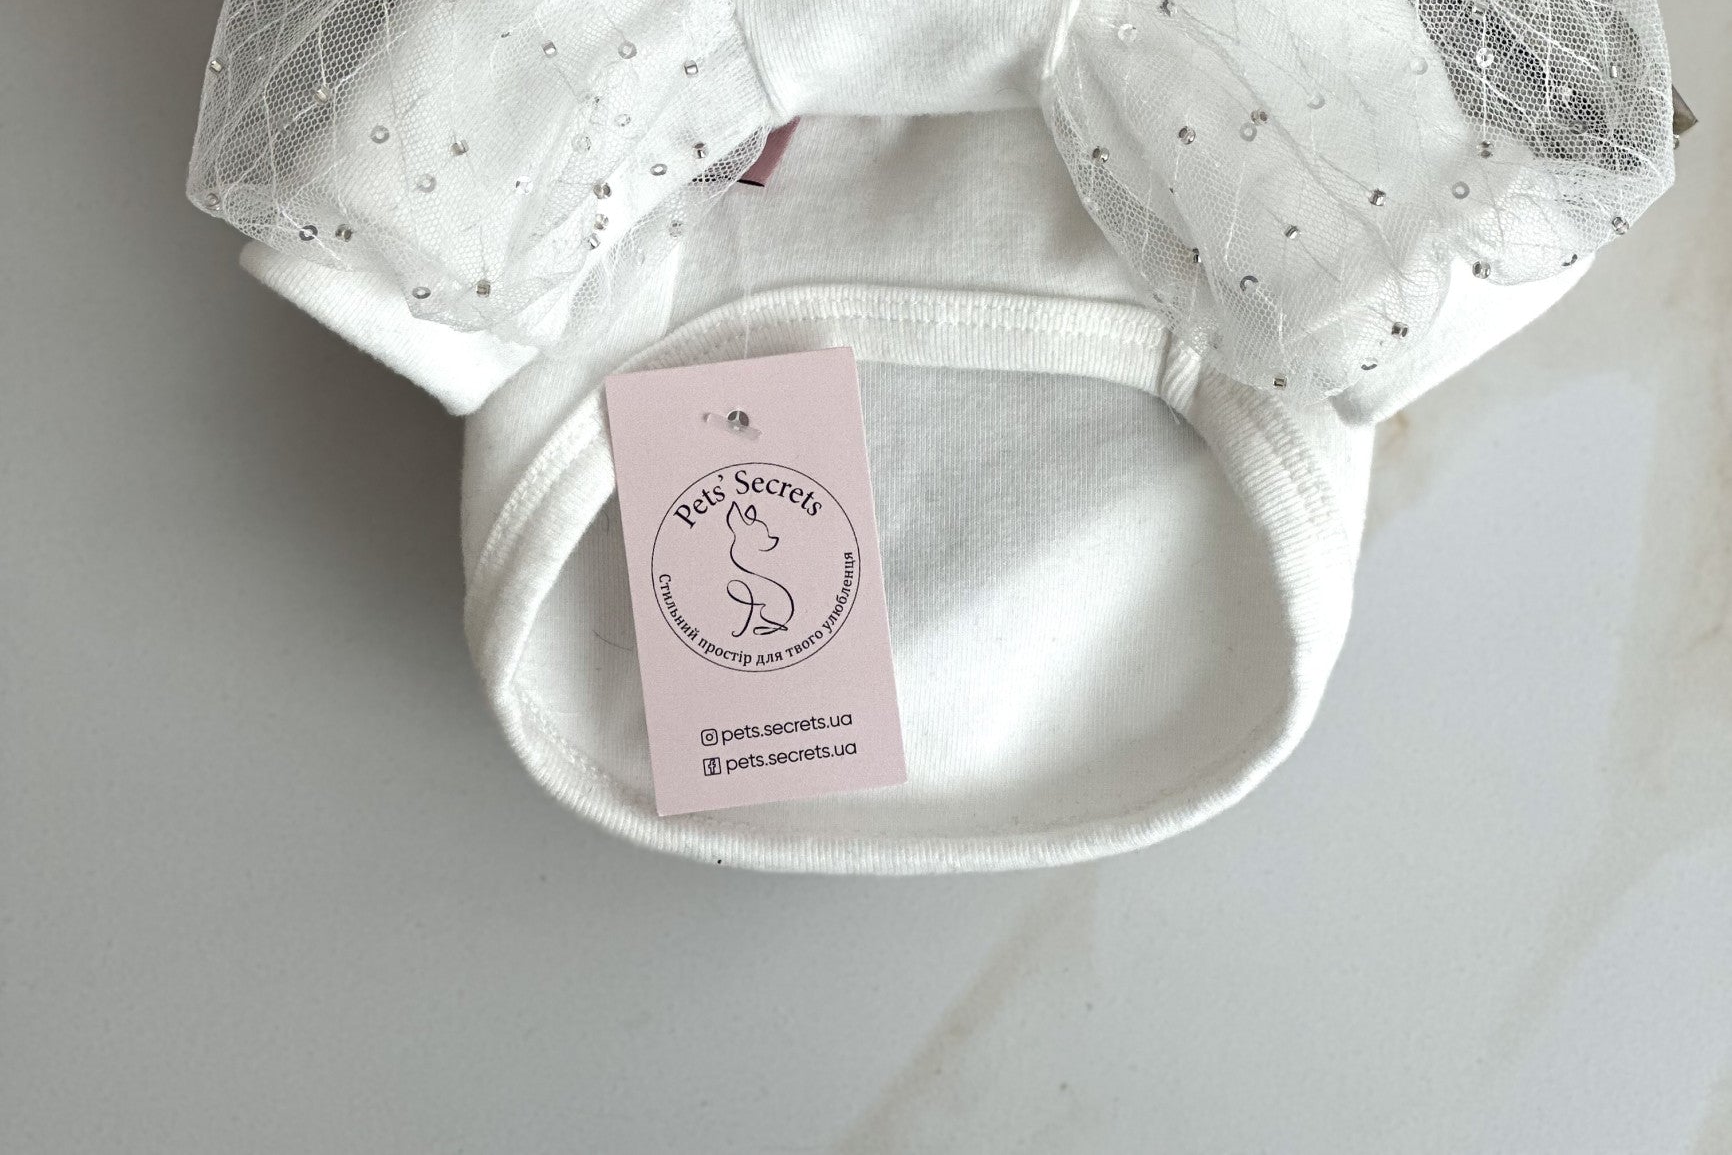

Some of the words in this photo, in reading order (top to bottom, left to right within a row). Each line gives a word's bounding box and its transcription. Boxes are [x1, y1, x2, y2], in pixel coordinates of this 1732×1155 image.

[734, 470, 822, 517] Secrets
[658, 573, 701, 641] Стильний
[697, 637, 752, 667] простір
[756, 651, 783, 666] для
[785, 632, 824, 658] твого
[822, 551, 856, 634] улюбленця
[721, 713, 853, 746] pets.secrets.ua
[725, 742, 857, 775] pets.secrets.ua
